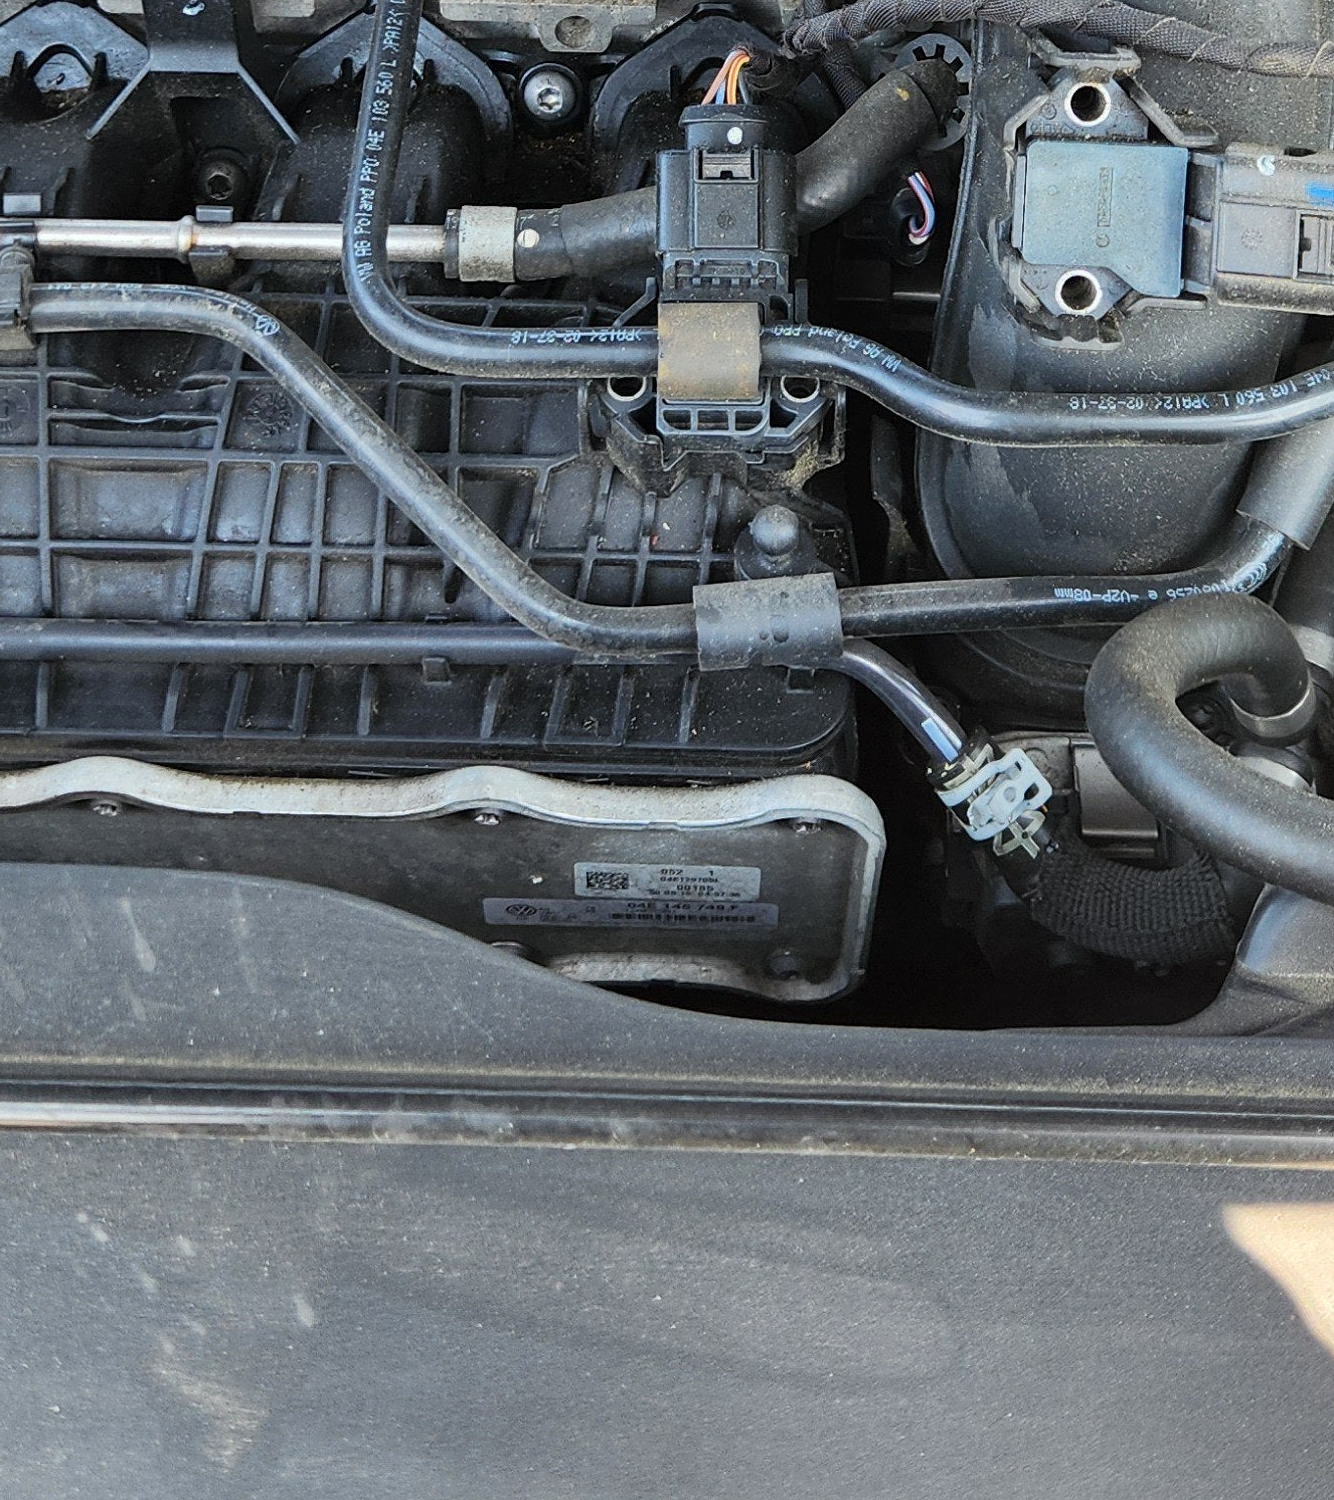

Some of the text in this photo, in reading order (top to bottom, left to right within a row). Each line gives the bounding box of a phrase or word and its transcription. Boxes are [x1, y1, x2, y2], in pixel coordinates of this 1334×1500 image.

[376, 71, 395, 97] 560
[370, 100, 390, 126] 103
[365, 129, 386, 153] 04E
[353, 187, 376, 236] Poland
[354, 237, 370, 260] AG
[807, 325, 862, 351] Poland
[863, 341, 884, 361] AG
[1067, 394, 1145, 411] 02-37-18
[1233, 387, 1265, 408] 560
